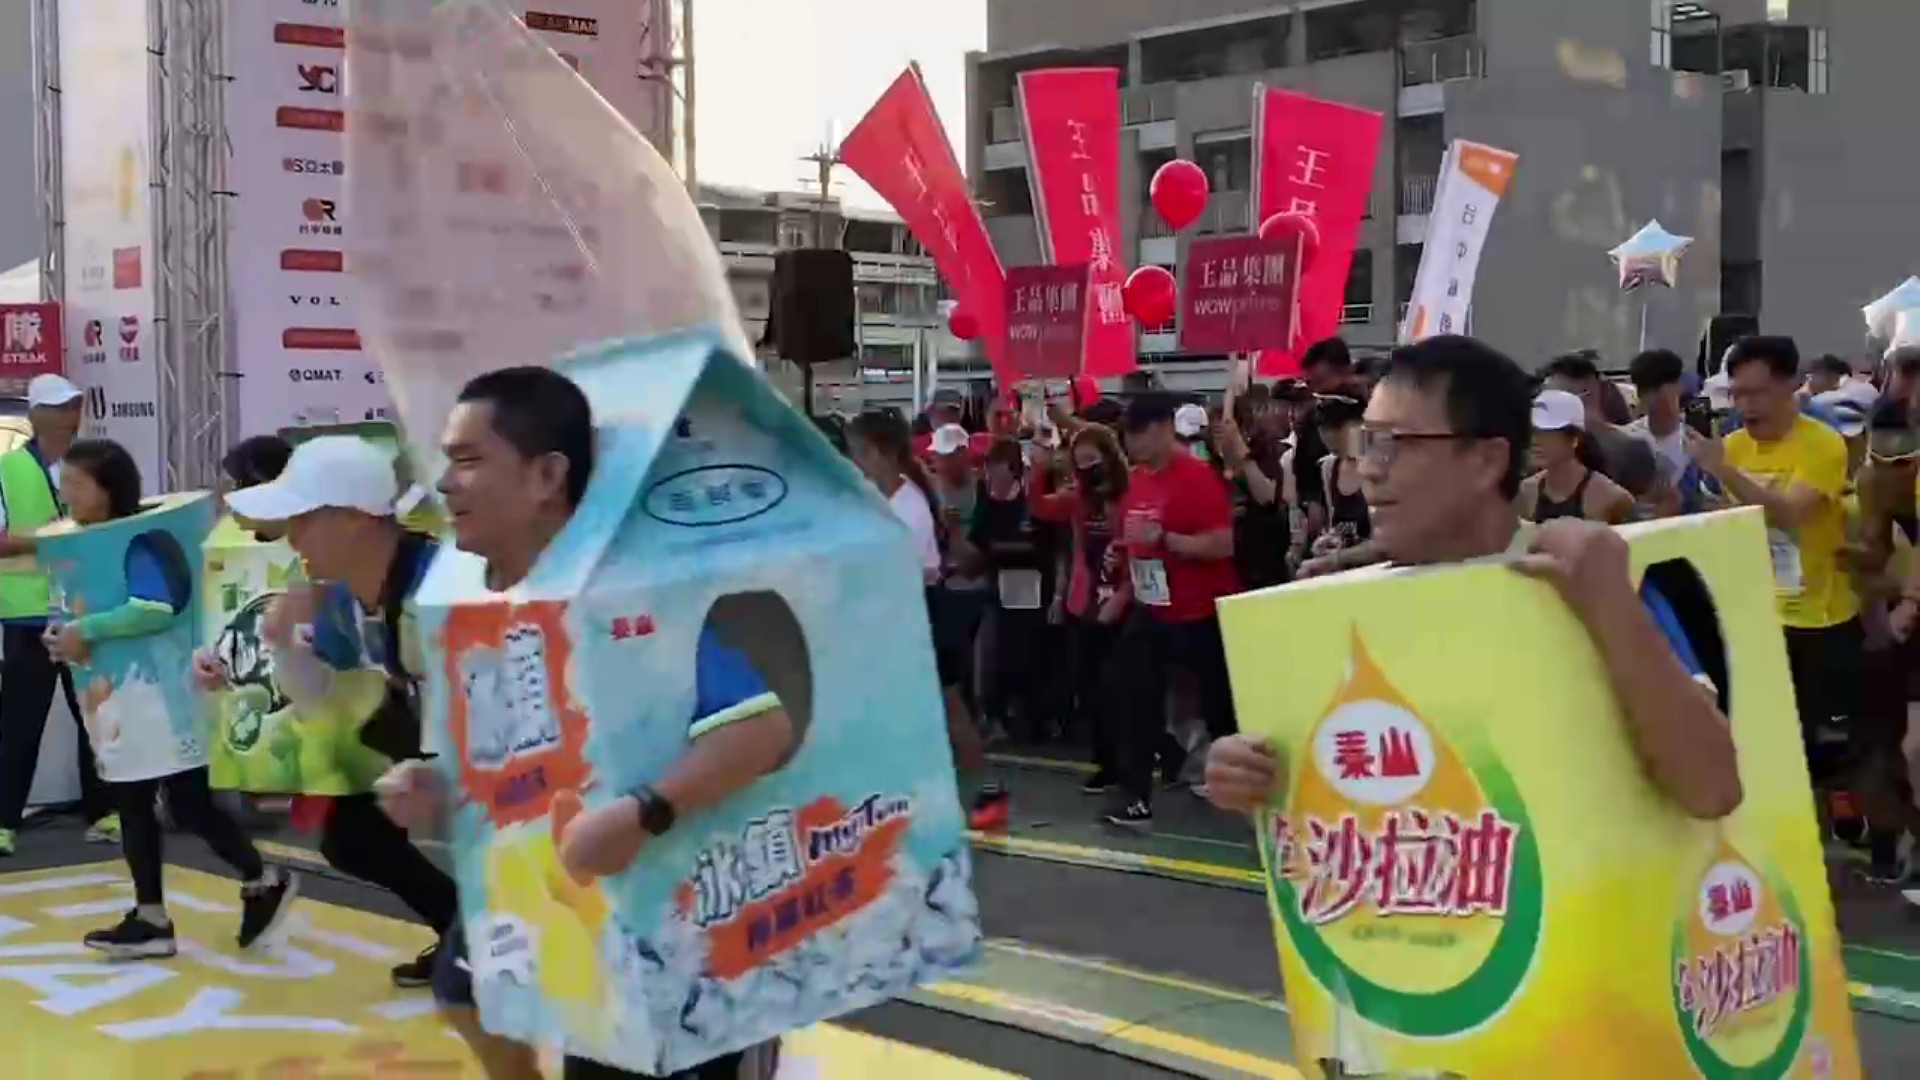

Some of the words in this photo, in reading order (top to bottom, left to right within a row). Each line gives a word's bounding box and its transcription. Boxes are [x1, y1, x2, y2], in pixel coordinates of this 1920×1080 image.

[1199, 253, 1285, 290] 王品集團
[1333, 726, 1421, 779] 泰山
